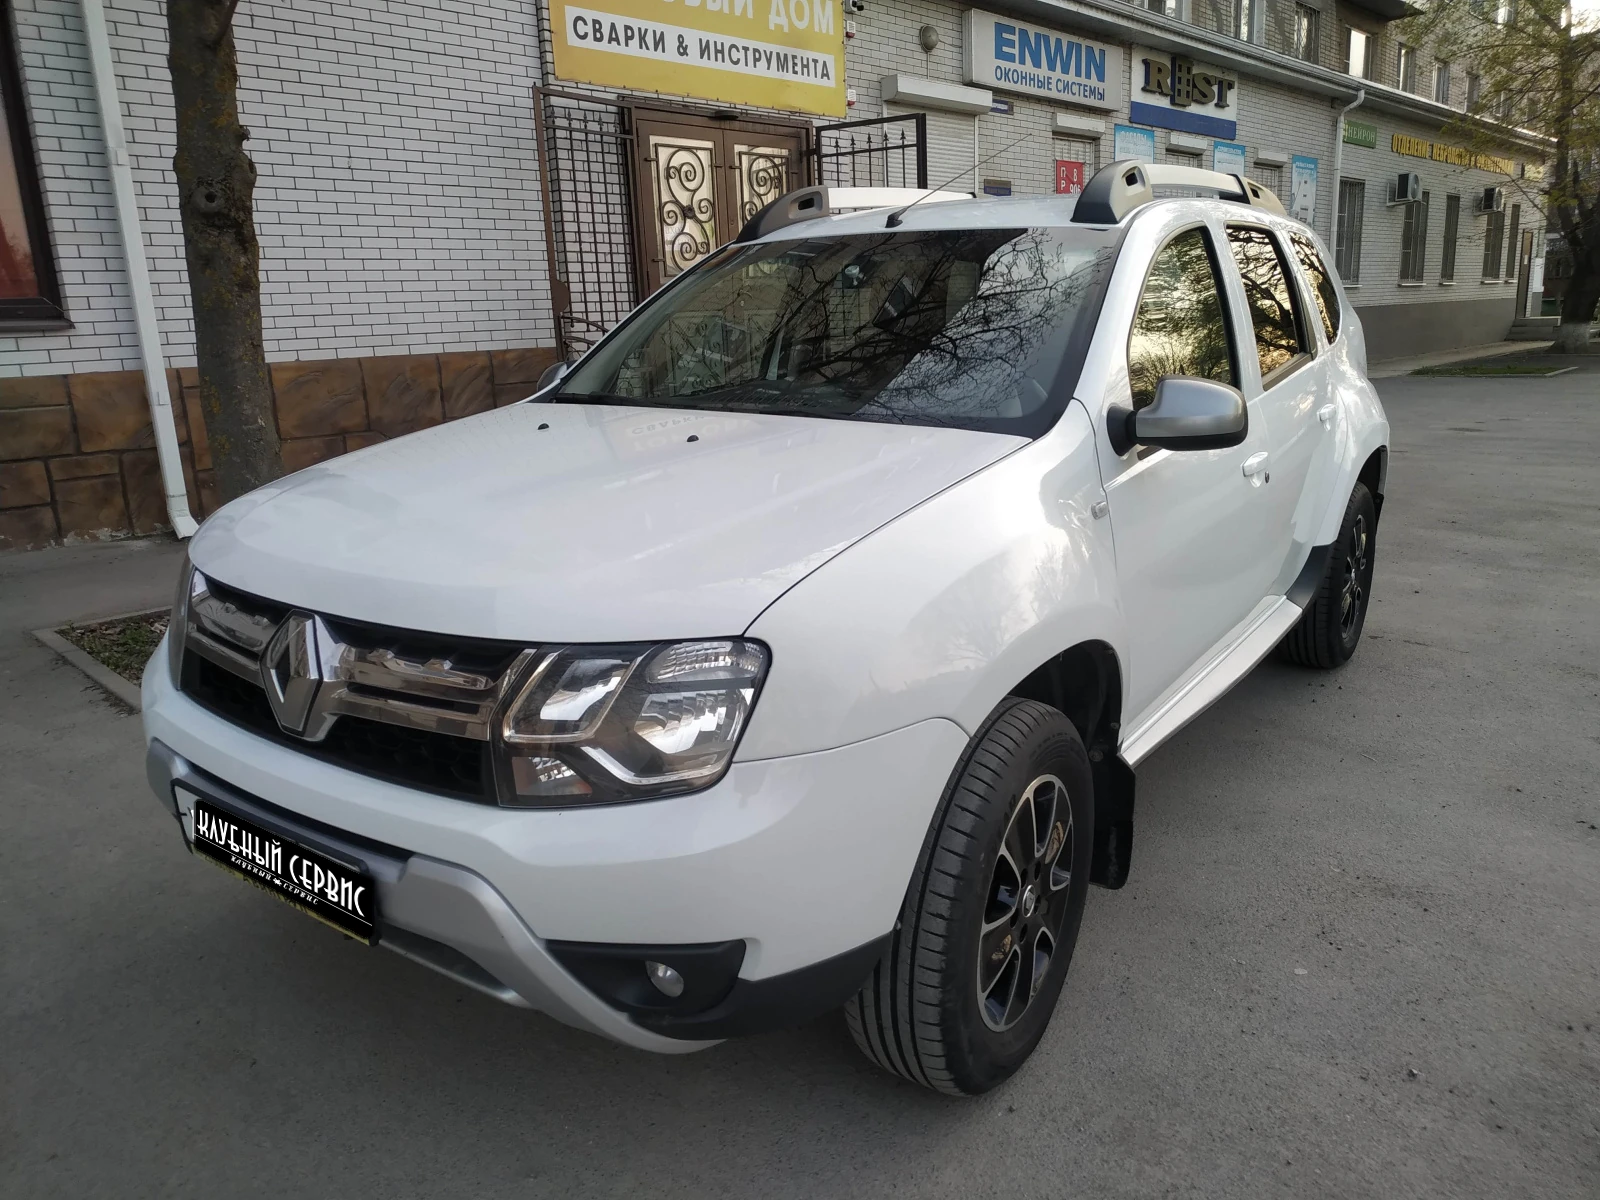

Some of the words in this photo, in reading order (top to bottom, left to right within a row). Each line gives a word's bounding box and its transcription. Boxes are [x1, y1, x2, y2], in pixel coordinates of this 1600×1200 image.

[768, 0, 834, 35] ДОМ
[572, 15, 666, 54] СВАРКИ
[677, 33, 689, 57] &
[699, 38, 831, 81] ИНСТРУМЕНТА
[994, 21, 1106, 83] ENWIN
[994, 65, 1053, 92] ОКОННЫЕ
[1055, 78, 1106, 102] СИСТЕМЫ
